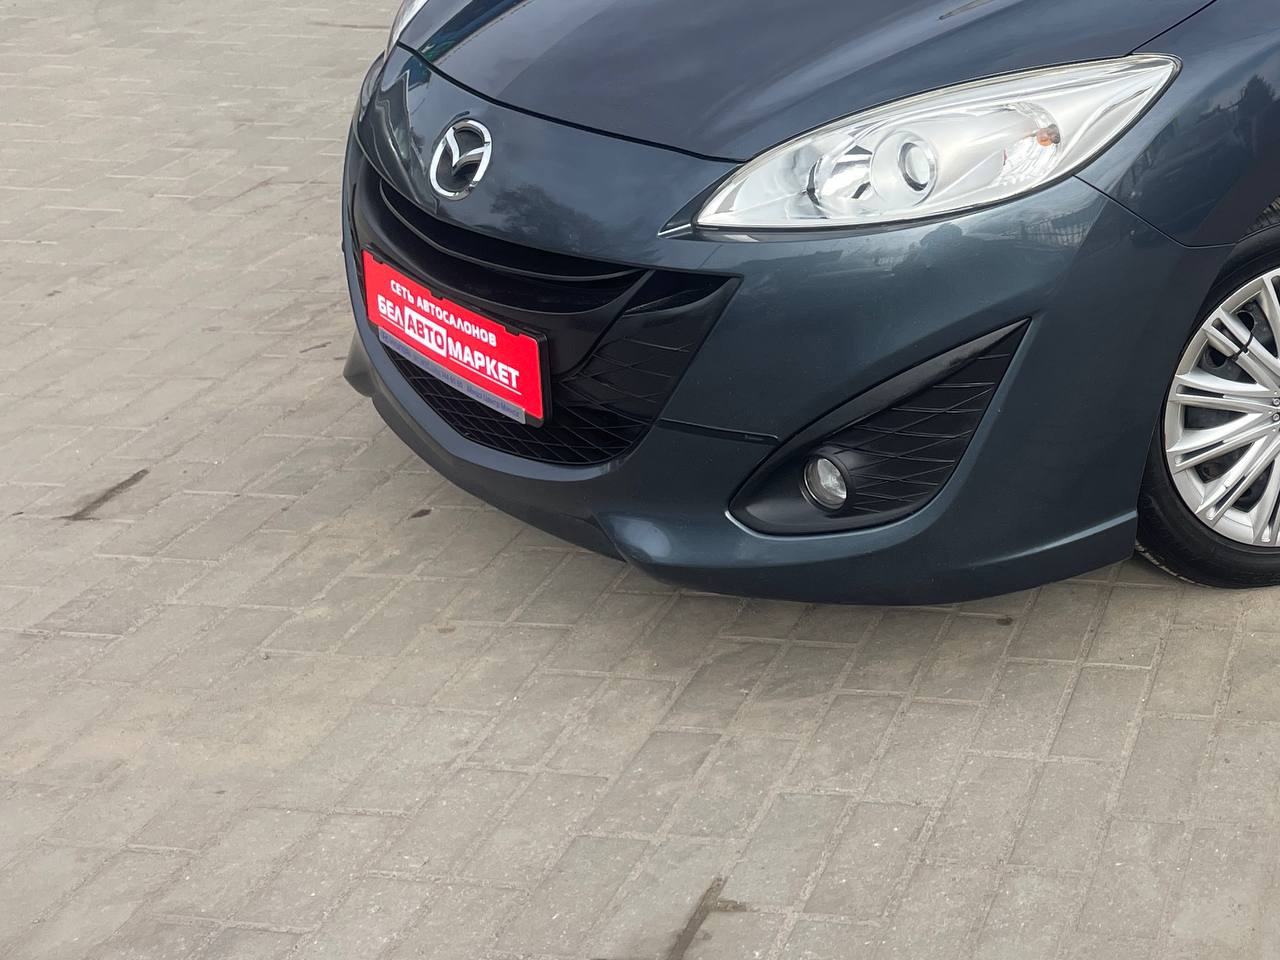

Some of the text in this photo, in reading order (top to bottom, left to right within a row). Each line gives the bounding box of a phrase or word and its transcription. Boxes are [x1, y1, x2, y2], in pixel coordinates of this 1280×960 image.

[377, 294, 404, 326] БЕЛ
[407, 314, 445, 351] АВТО
[448, 337, 520, 389] МАРКЕТ
[390, 279, 415, 305] СЕТЬ
[416, 296, 497, 348] АВТОСАЛОНОВ
